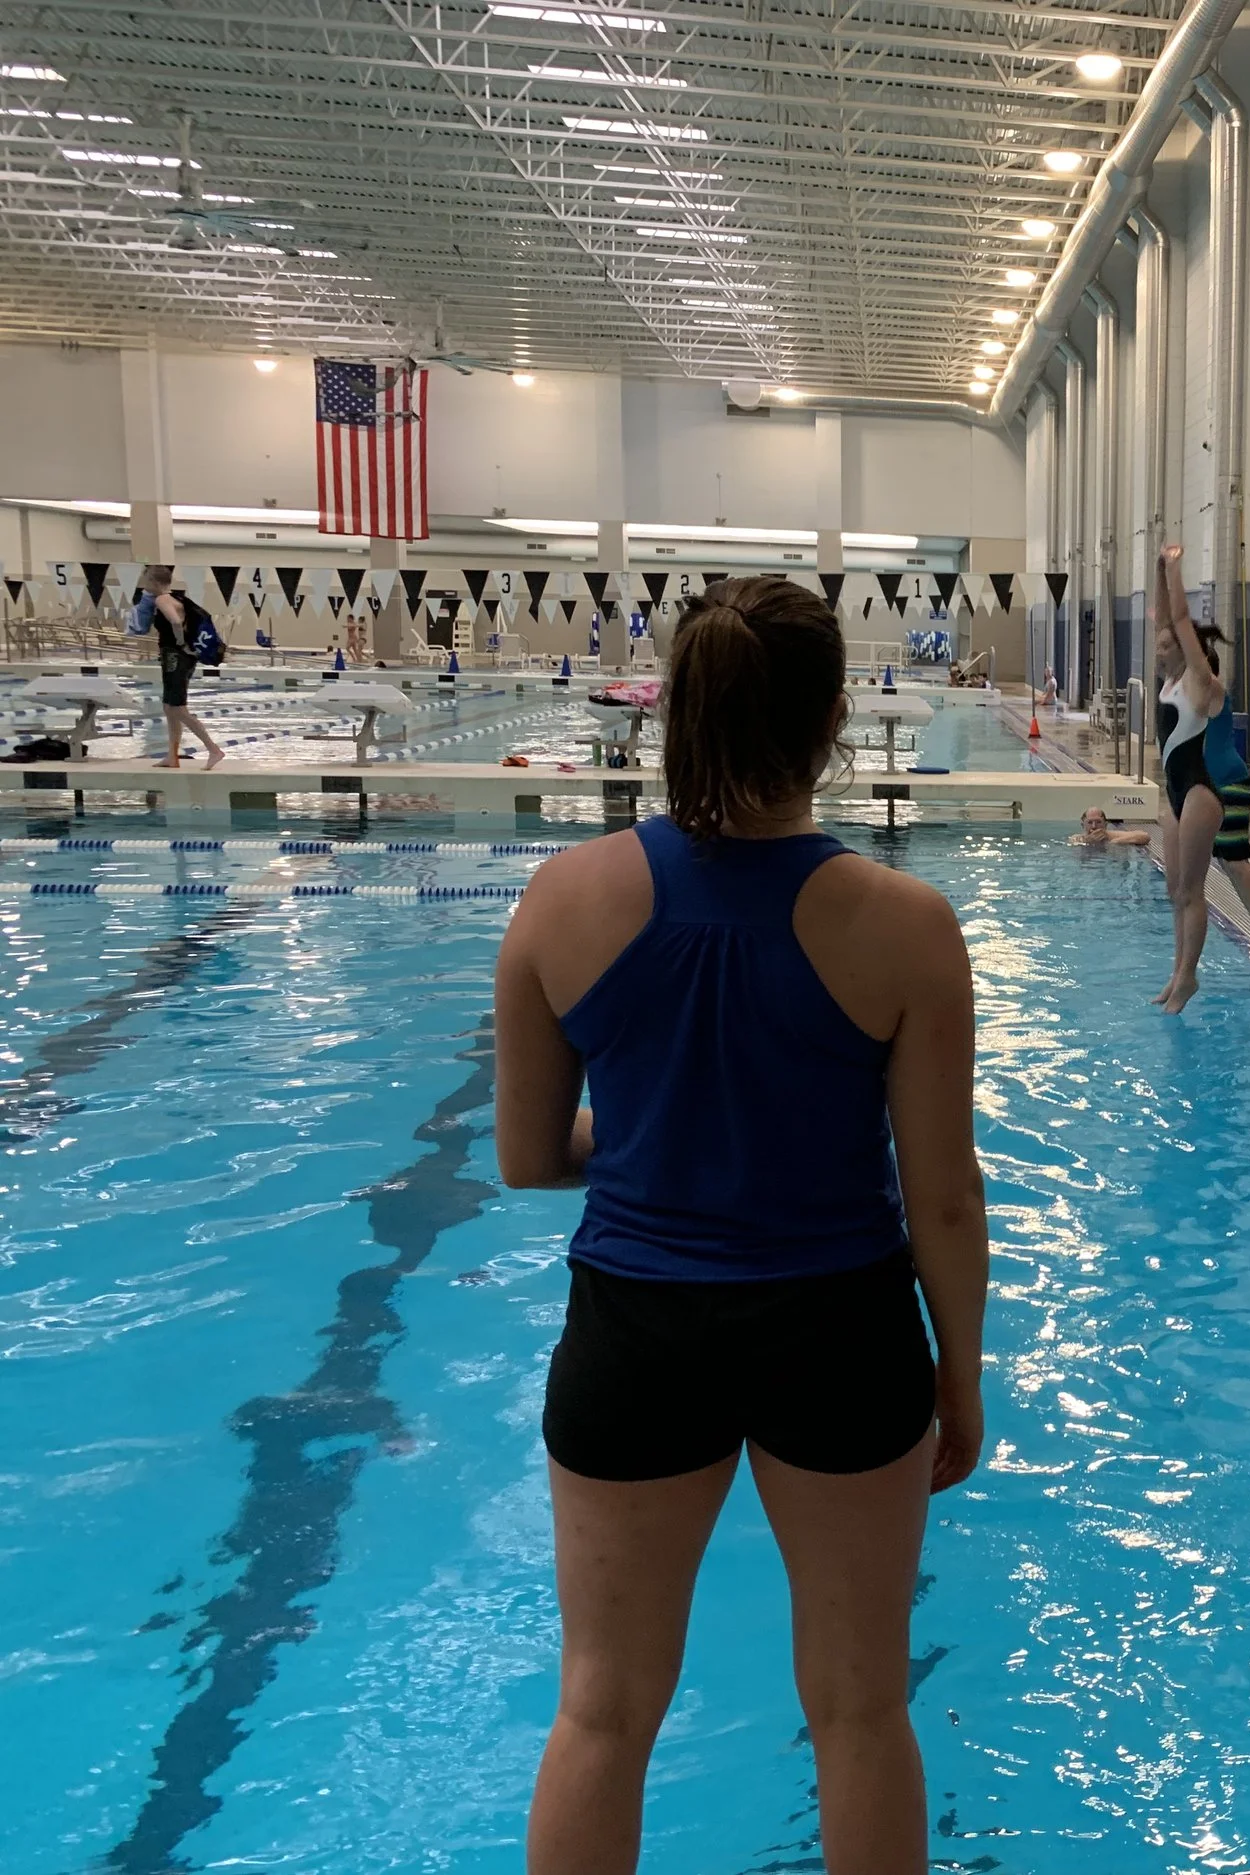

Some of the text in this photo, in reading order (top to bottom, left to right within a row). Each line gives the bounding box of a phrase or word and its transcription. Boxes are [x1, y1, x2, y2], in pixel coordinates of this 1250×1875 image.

[56, 564, 67, 585] 5
[252, 567, 262, 588] 4
[501, 573, 511, 594] 3
[681, 574, 690, 595] 2
[914, 578, 922, 598] 1
